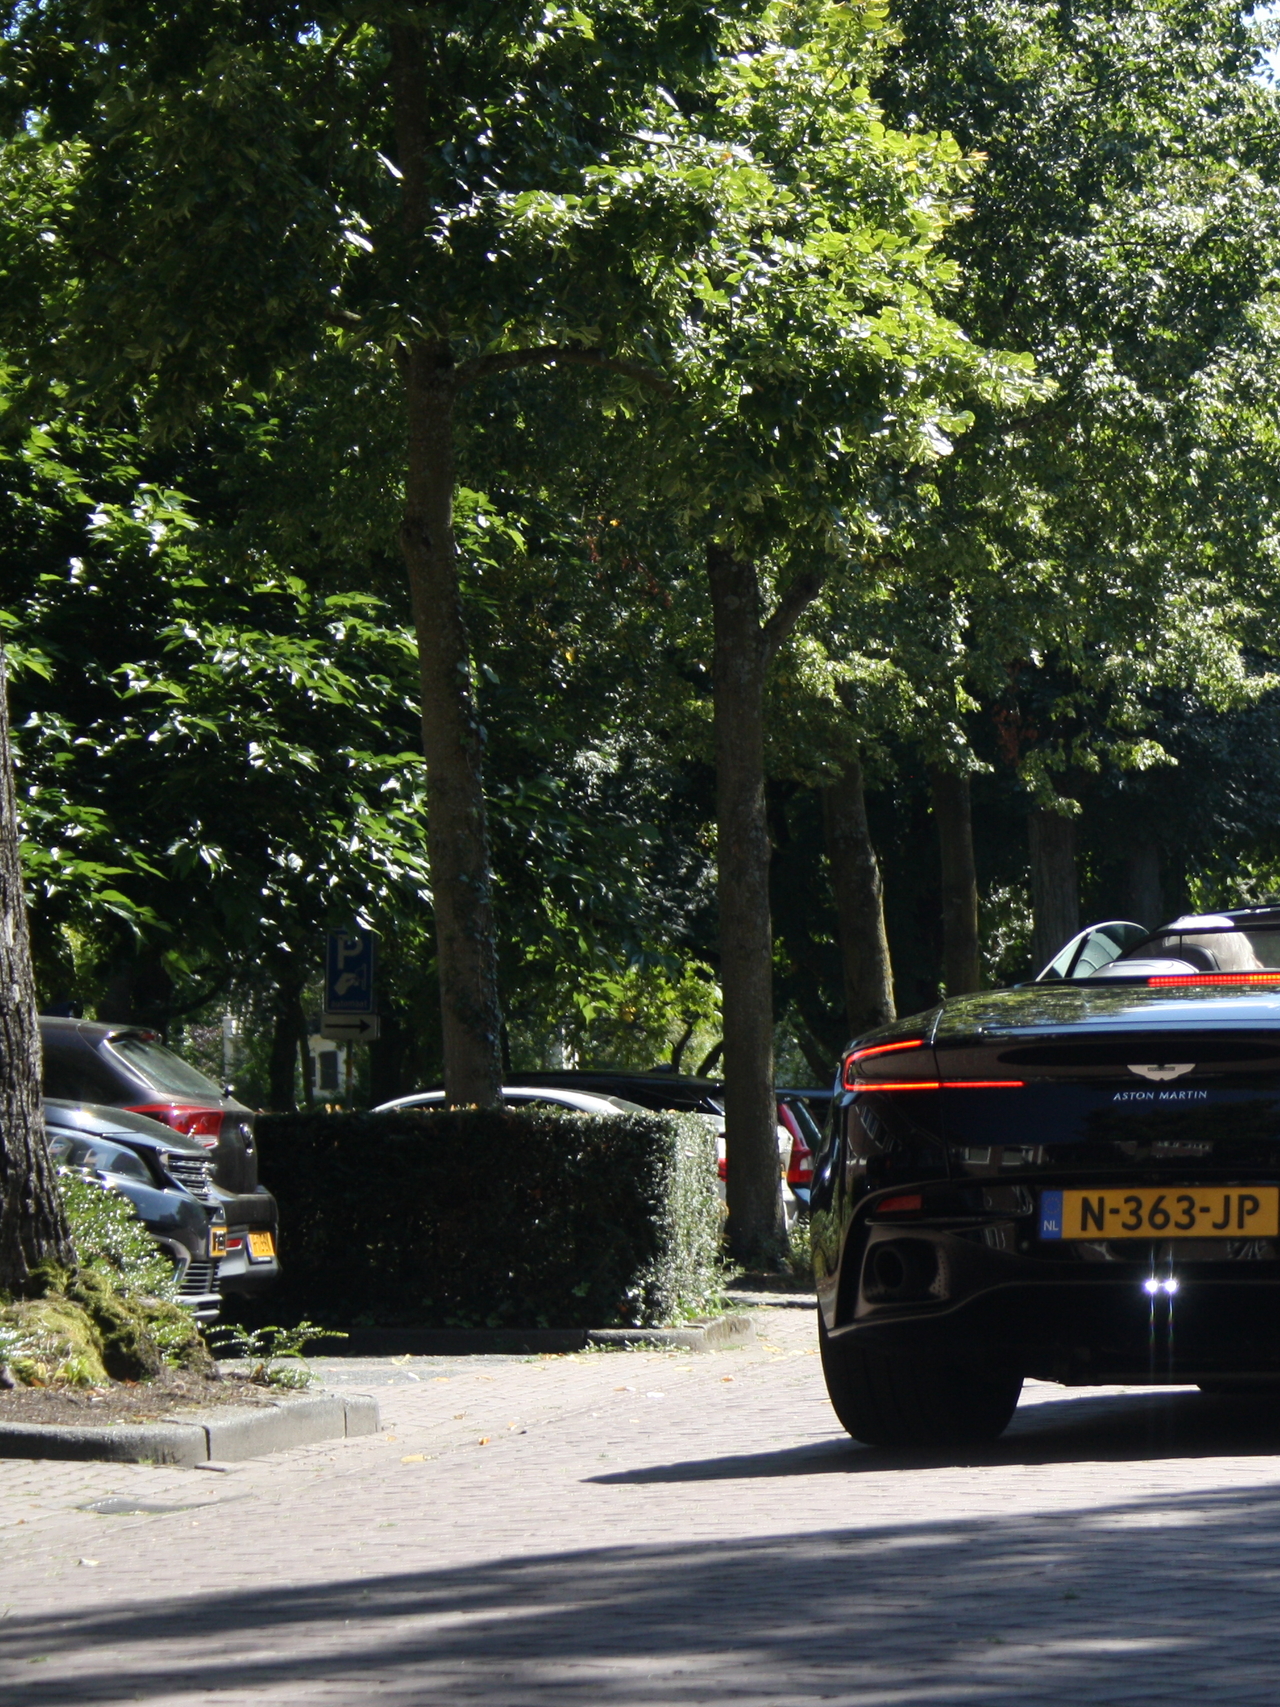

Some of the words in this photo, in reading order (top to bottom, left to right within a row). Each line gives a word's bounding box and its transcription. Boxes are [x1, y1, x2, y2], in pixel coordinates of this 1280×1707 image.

[337, 934, 364, 970] P
[1113, 1091, 1155, 1101] ASTON
[1158, 1090, 1208, 1100] MARTIN
[1080, 1194, 1260, 1231] N-363-JP
[1043, 1220, 1059, 1231] NL
